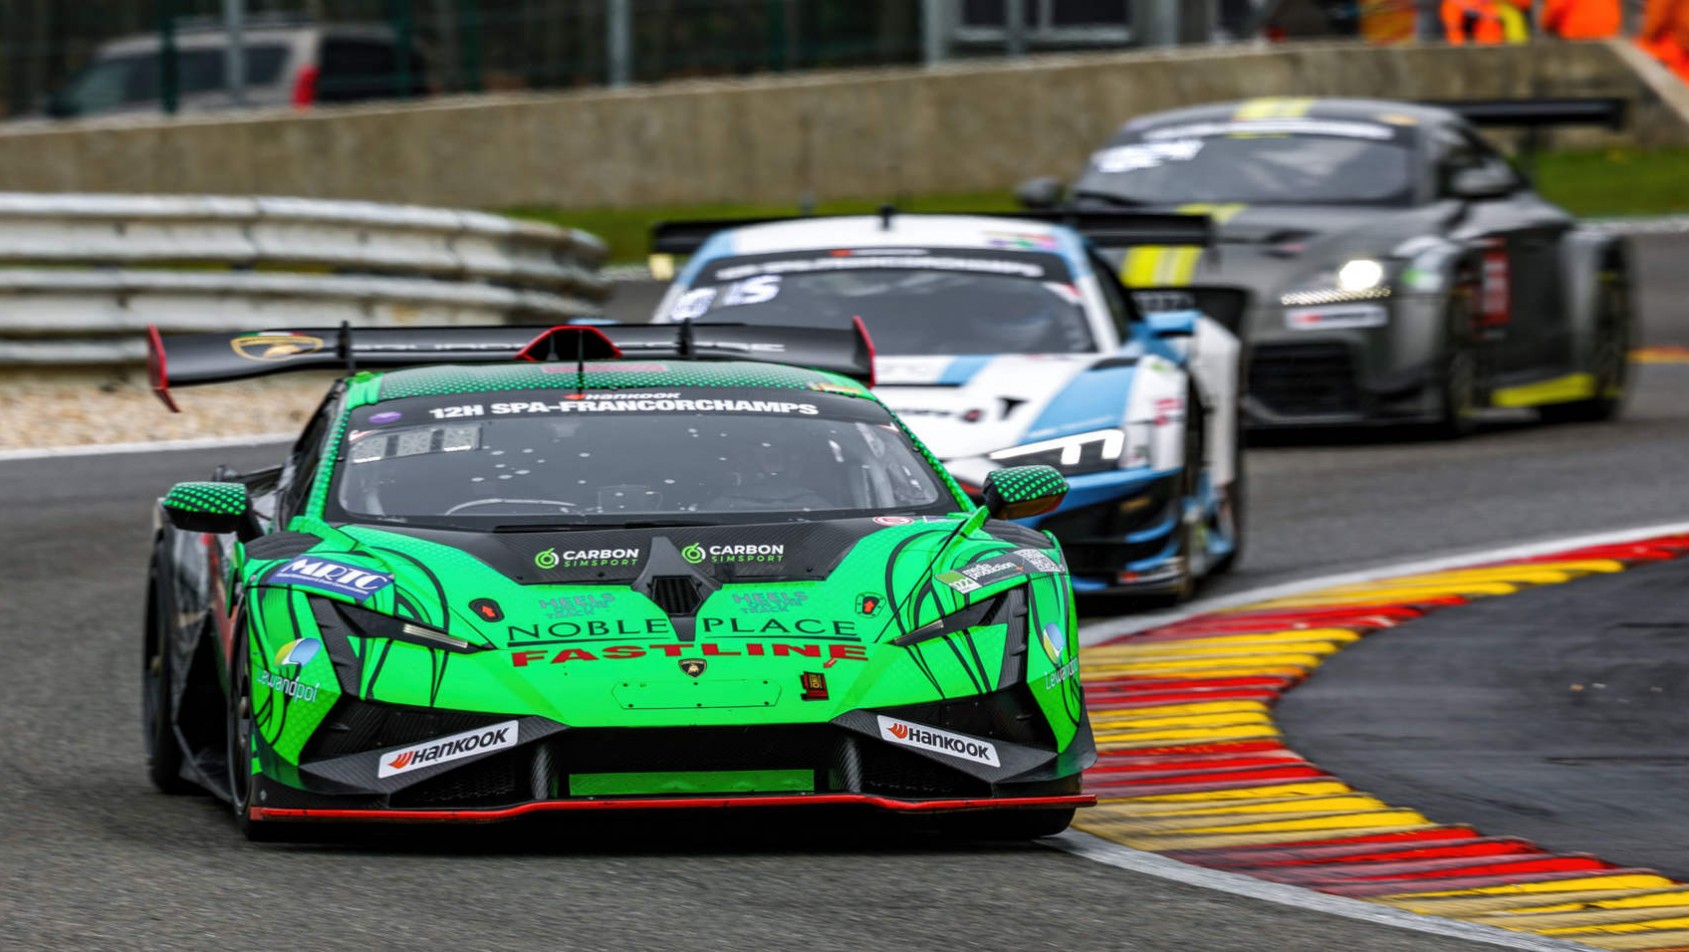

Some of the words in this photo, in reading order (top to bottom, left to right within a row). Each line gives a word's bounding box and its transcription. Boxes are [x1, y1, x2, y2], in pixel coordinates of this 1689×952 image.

[429, 404, 484, 419] 12H
[491, 400, 819, 415] SPA-FRANCORCHAMPS
[562, 548, 640, 560] CARBON
[709, 544, 784, 555] CARBON
[563, 558, 638, 567] SIMSPORT
[280, 558, 388, 590] MRTC
[732, 591, 808, 603] HEELS
[507, 618, 669, 641] NOBLE
[702, 618, 857, 637] PLACE
[512, 643, 868, 667] FASTLINE
